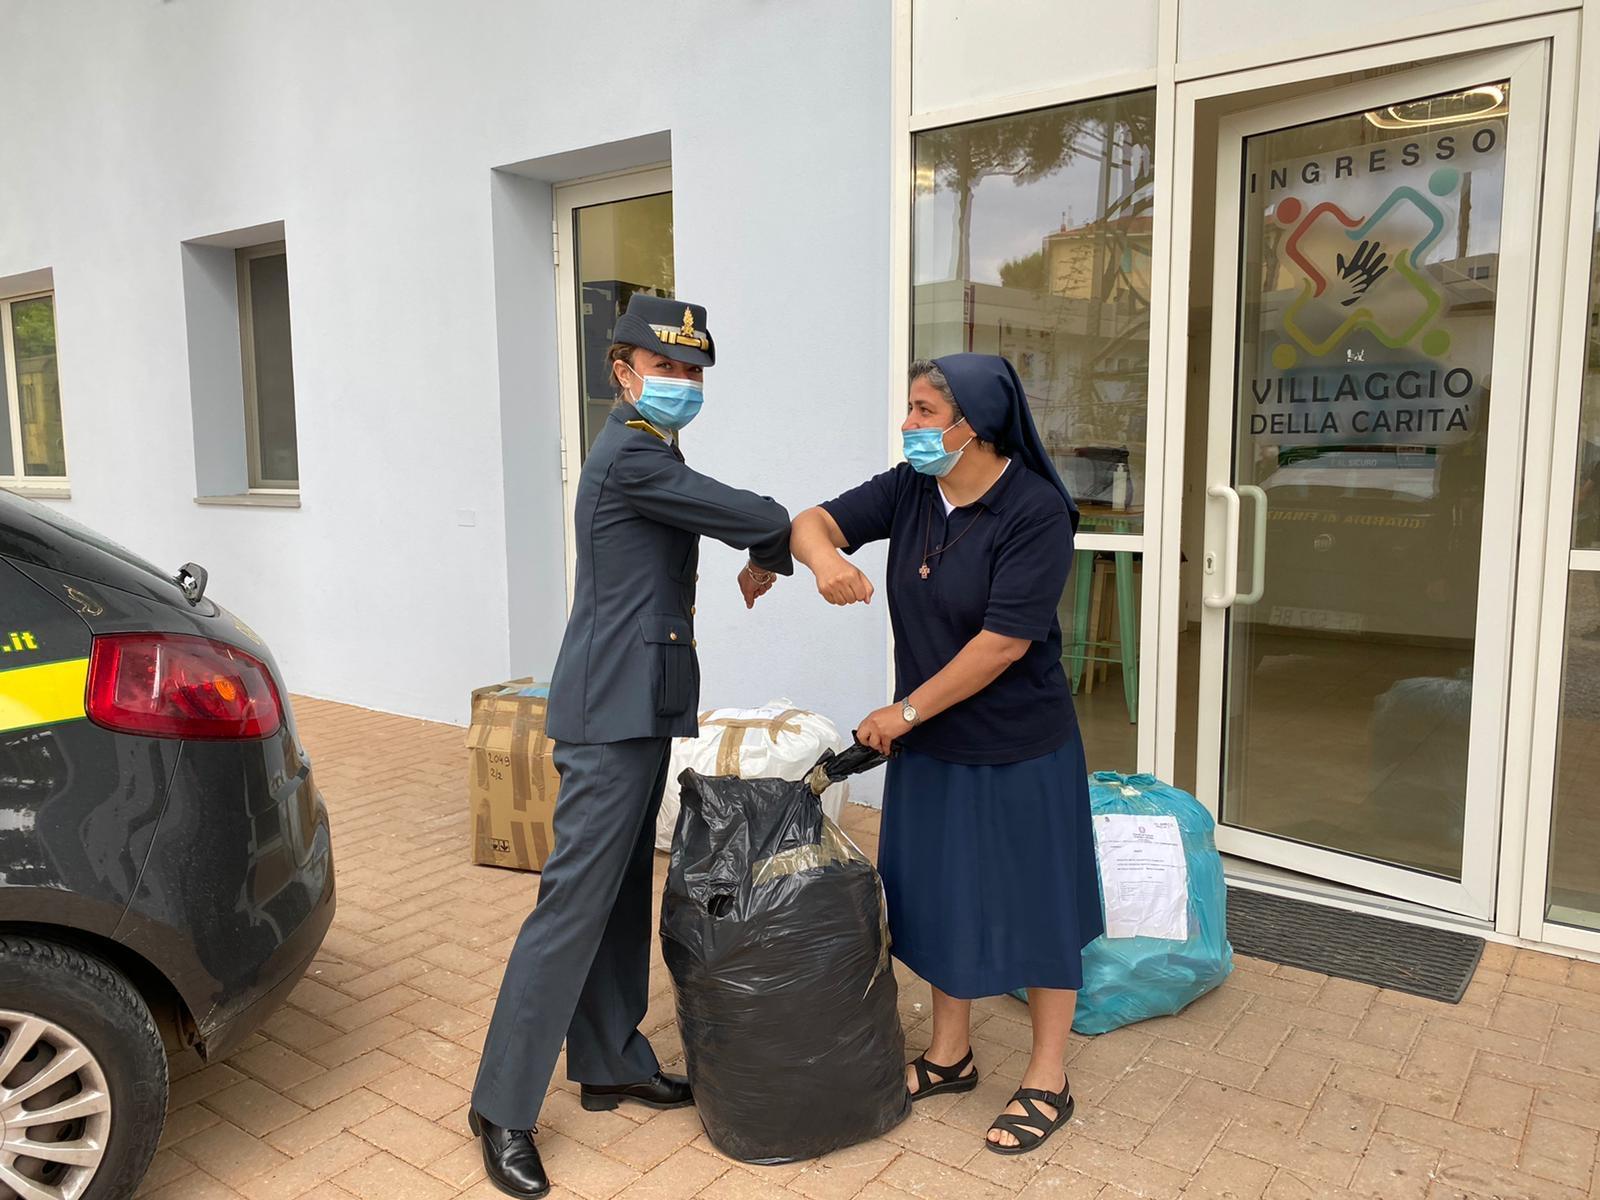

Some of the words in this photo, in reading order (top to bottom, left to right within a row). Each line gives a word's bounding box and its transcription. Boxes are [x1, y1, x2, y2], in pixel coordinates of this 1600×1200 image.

[1250, 128, 1496, 193] INGRESSO
[1252, 367, 1474, 405] VILLAGGIO
[1250, 411, 1339, 435] DELLA
